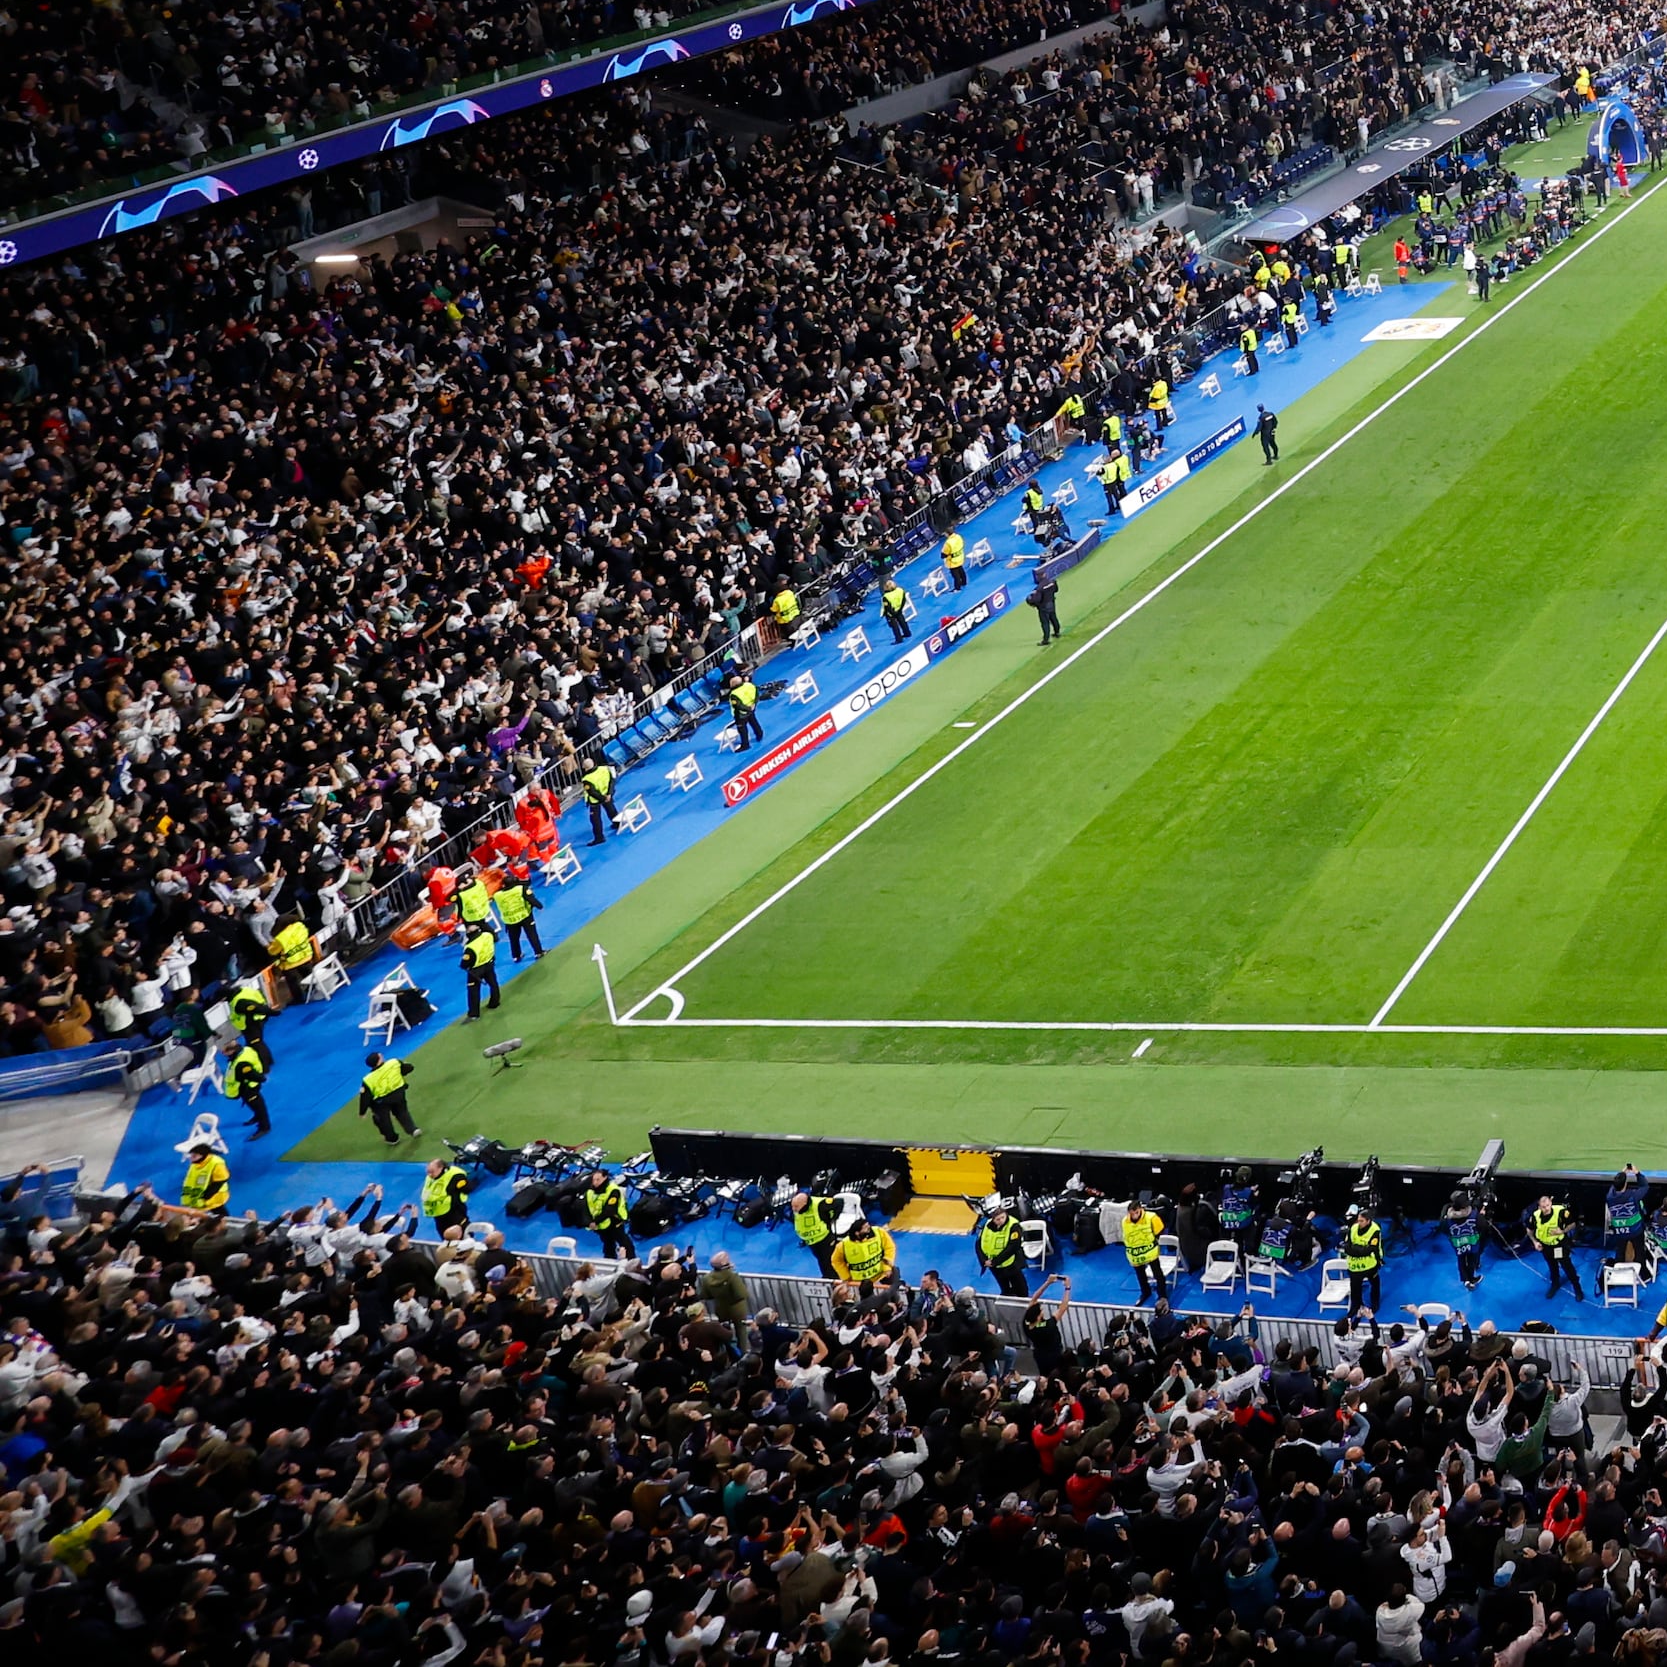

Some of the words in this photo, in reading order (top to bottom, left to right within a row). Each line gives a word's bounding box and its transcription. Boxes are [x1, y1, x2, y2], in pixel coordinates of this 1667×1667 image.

[1207, 442, 1216, 452] TO
[1139, 474, 1172, 503] FedEx
[946, 604, 990, 642] PEPSI
[850, 660, 912, 712] oppo
[748, 747, 792, 783] TURKISH
[792, 718, 834, 754] AIRLINES
[1456, 1245, 1472, 1255] 209
